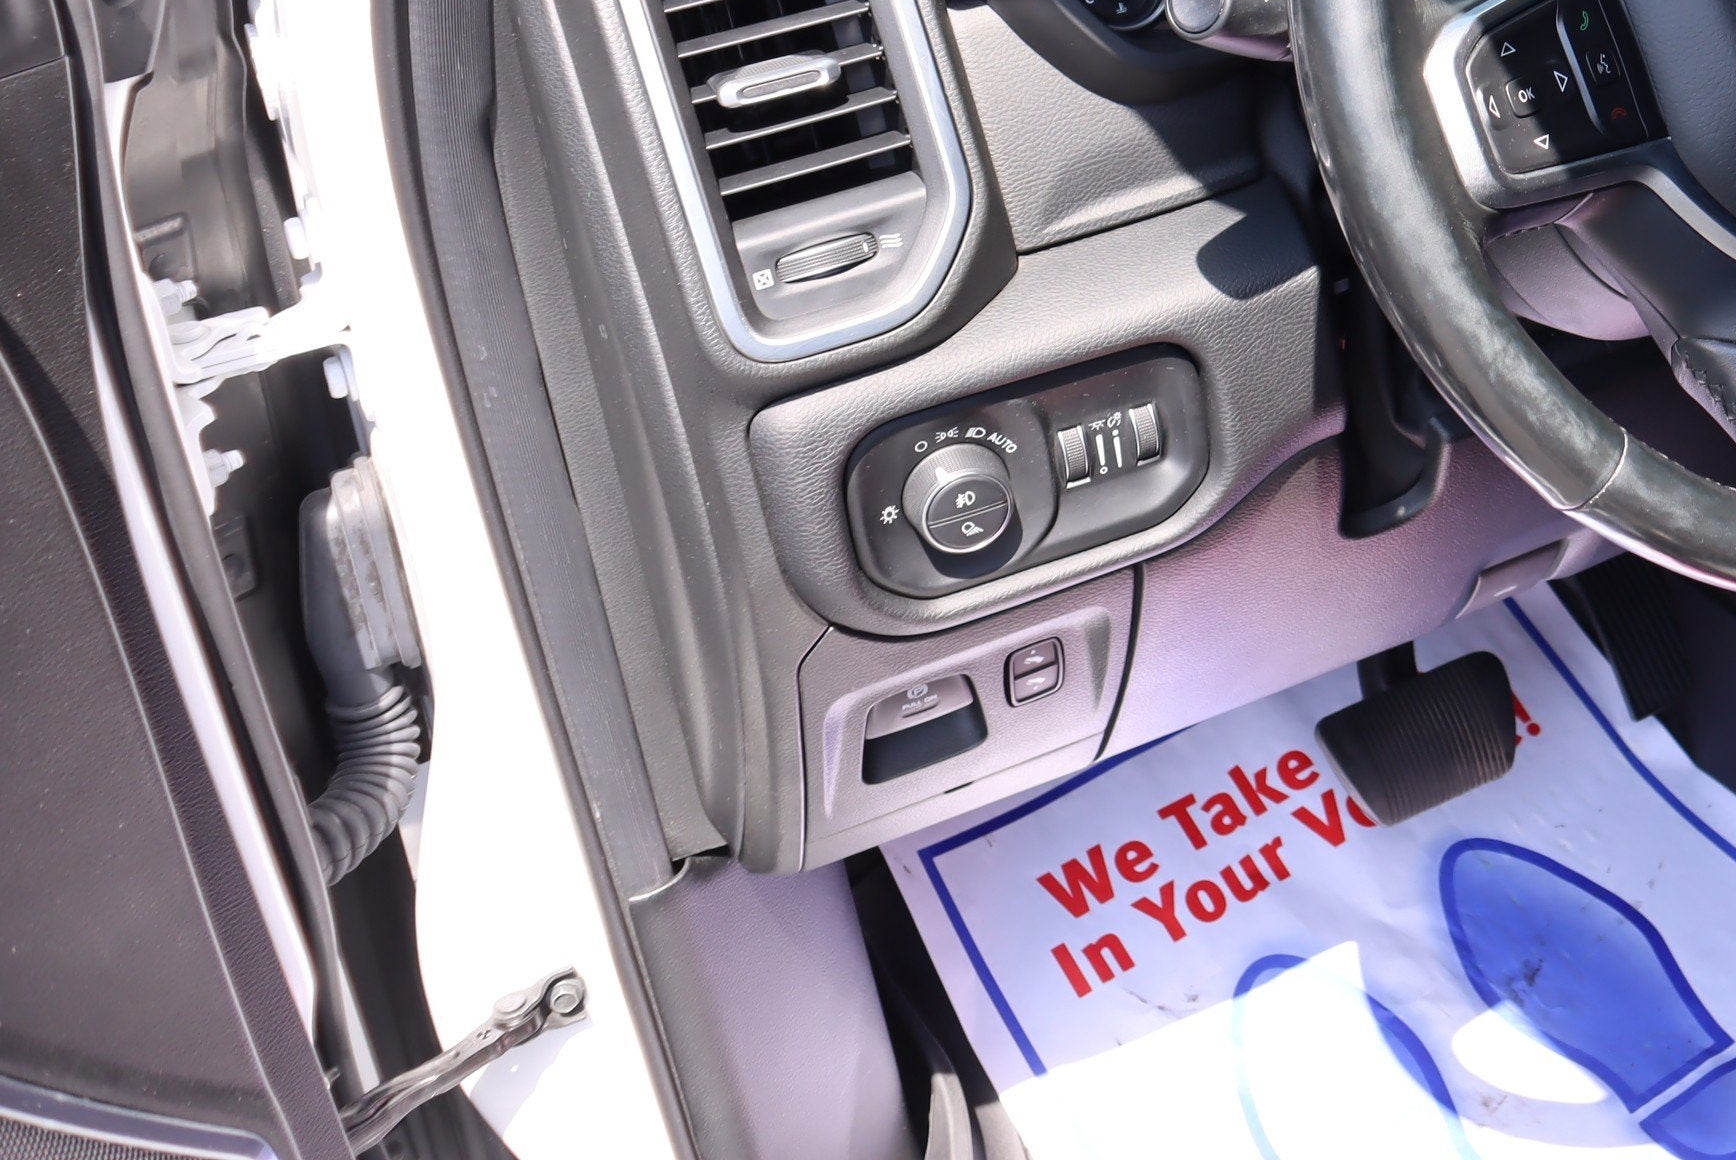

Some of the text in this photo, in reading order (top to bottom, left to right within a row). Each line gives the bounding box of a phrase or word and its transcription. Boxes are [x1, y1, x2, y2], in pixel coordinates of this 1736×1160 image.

[1518, 88, 1536, 104] OK
[987, 432, 1018, 454] AUTO
[1036, 840, 1160, 919] We
[1157, 750, 1320, 851] Take
[1051, 836, 1292, 998] In Your
